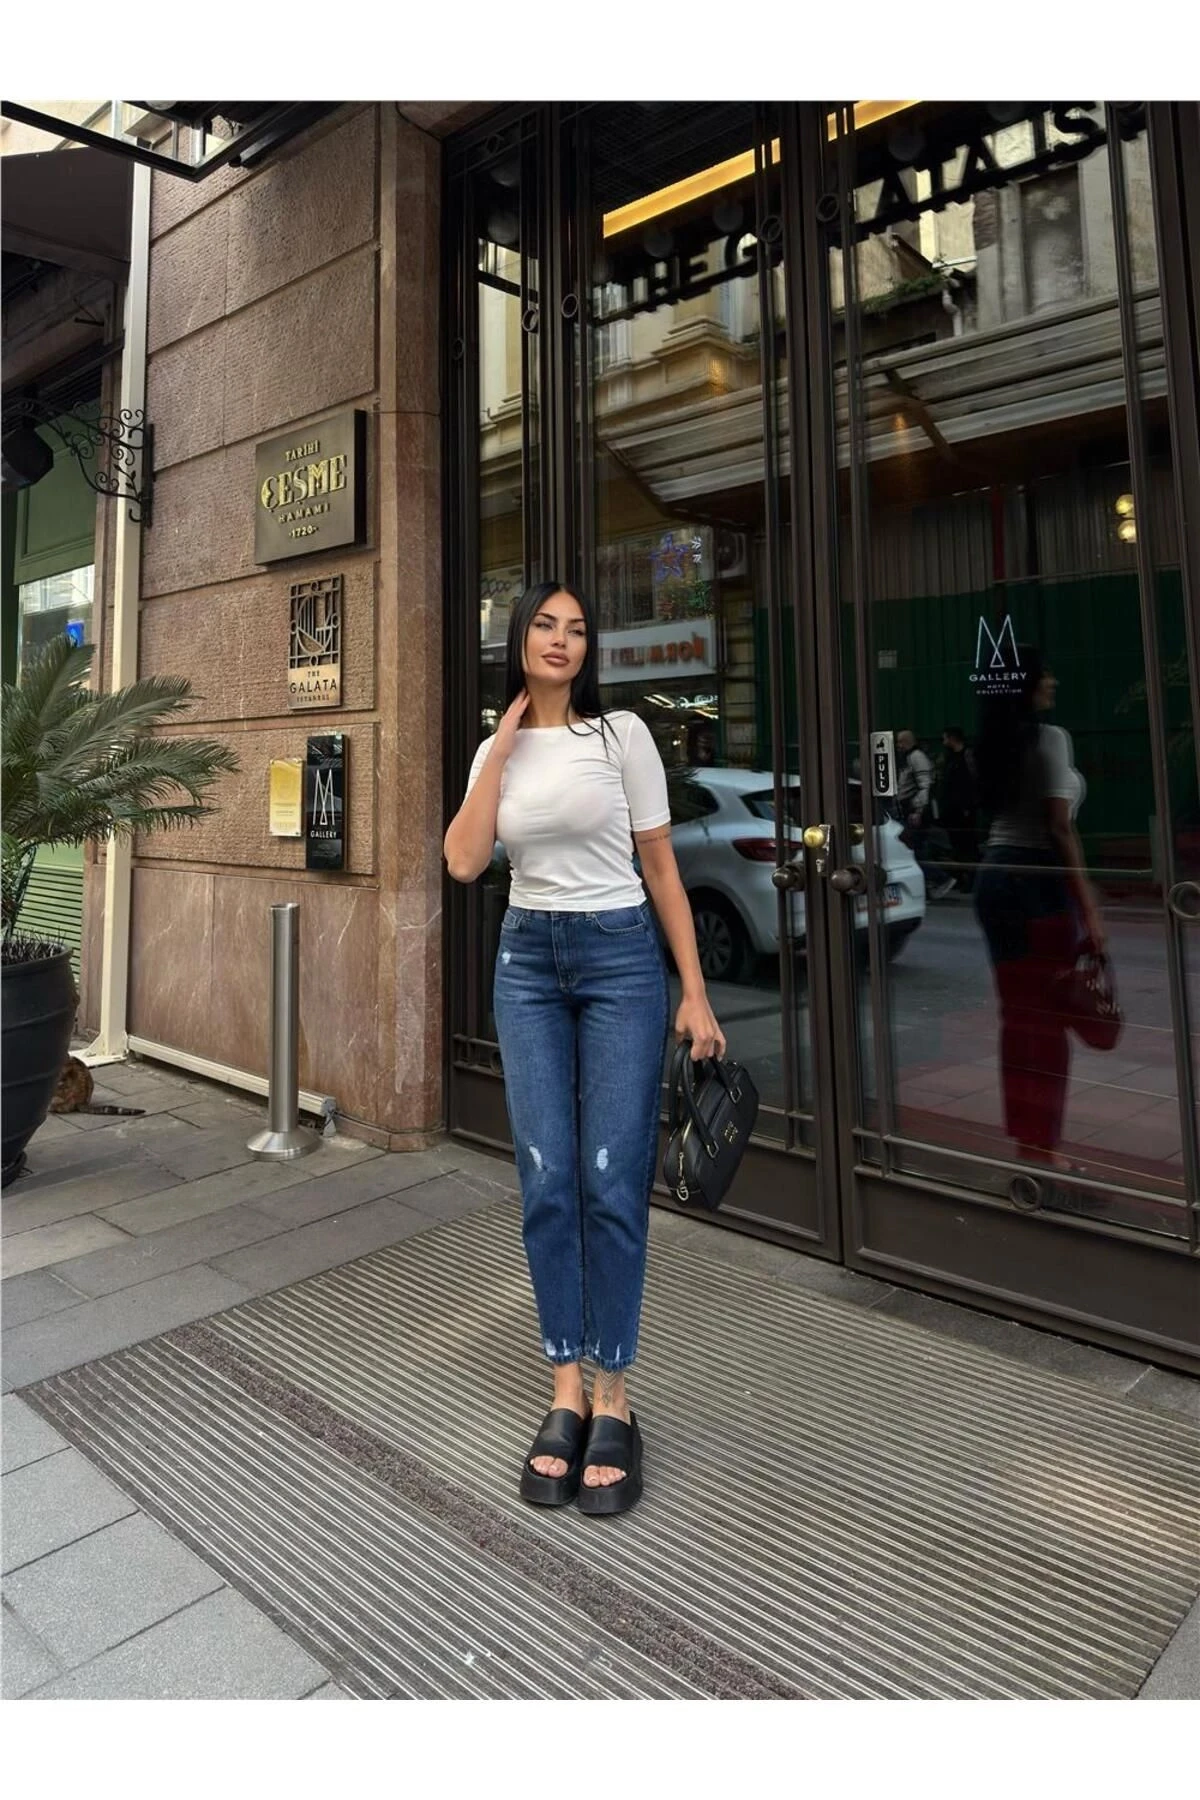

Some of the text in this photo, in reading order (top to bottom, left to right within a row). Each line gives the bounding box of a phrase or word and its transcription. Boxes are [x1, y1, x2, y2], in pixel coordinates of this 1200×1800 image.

[261, 454, 347, 512] ÇEŞME
[278, 503, 330, 523] HAMAMI
[968, 671, 1028, 682] GALLERY
[290, 679, 337, 693] GALATA
[878, 756, 886, 789] PULL
[310, 830, 337, 839] GALLERY
